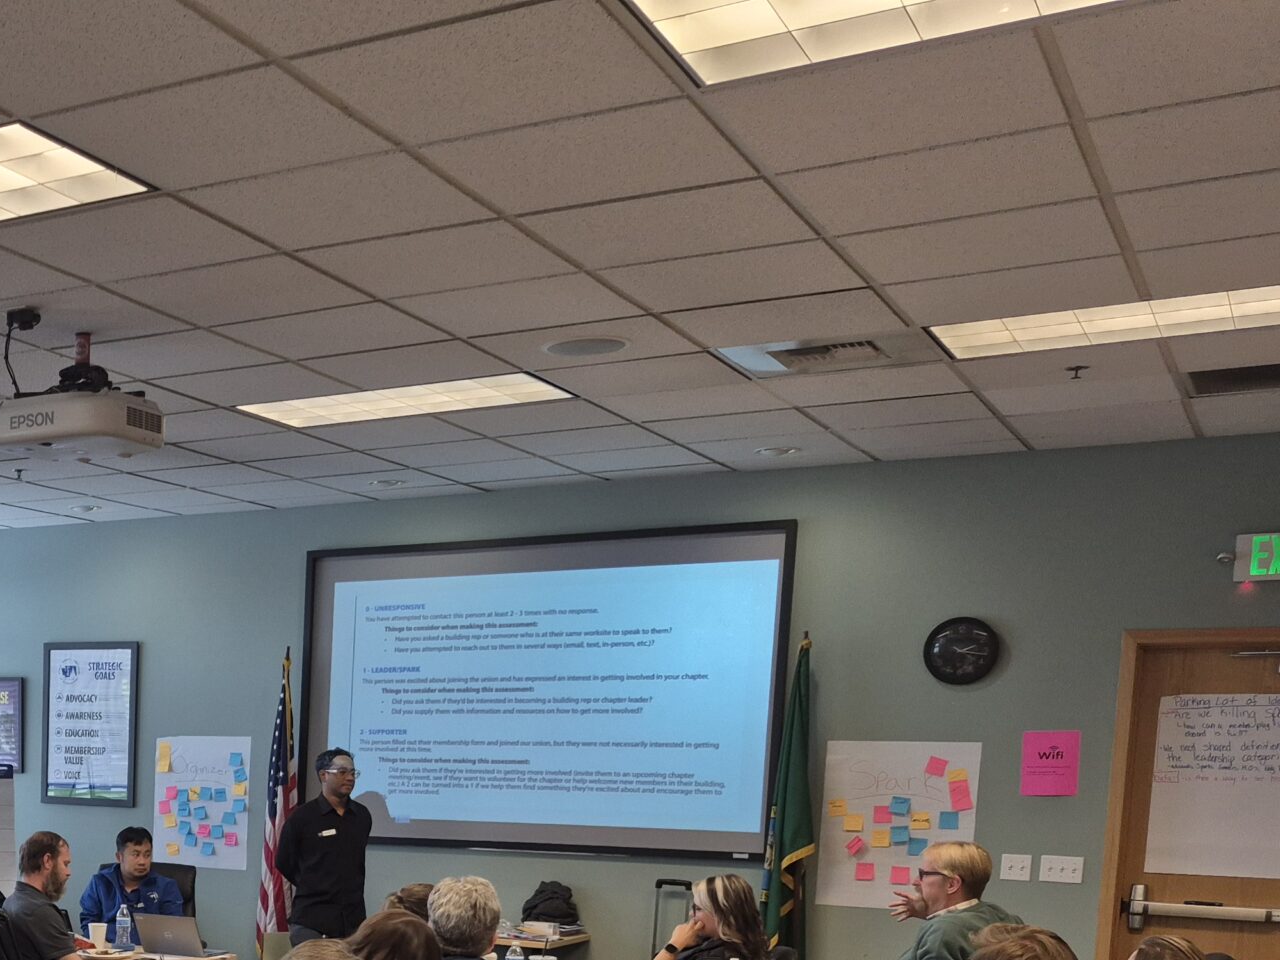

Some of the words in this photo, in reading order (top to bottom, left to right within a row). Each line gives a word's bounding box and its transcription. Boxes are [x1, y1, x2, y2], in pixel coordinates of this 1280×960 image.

[10, 411, 55, 430] EPSON
[88, 662, 123, 671] STRATEGIC
[95, 672, 116, 680] GOALS
[65, 694, 97, 703] ADVOCACY
[1174, 695, 1211, 707] Parking
[1216, 695, 1239, 705] Lot
[65, 712, 102, 720] AWARENESS
[65, 729, 99, 738] EDUCATION
[64, 746, 106, 755] MEMBERSHIP
[1038, 751, 1064, 760] Wifi
[64, 756, 84, 765] VALUE
[64, 771, 81, 780] VOICE
